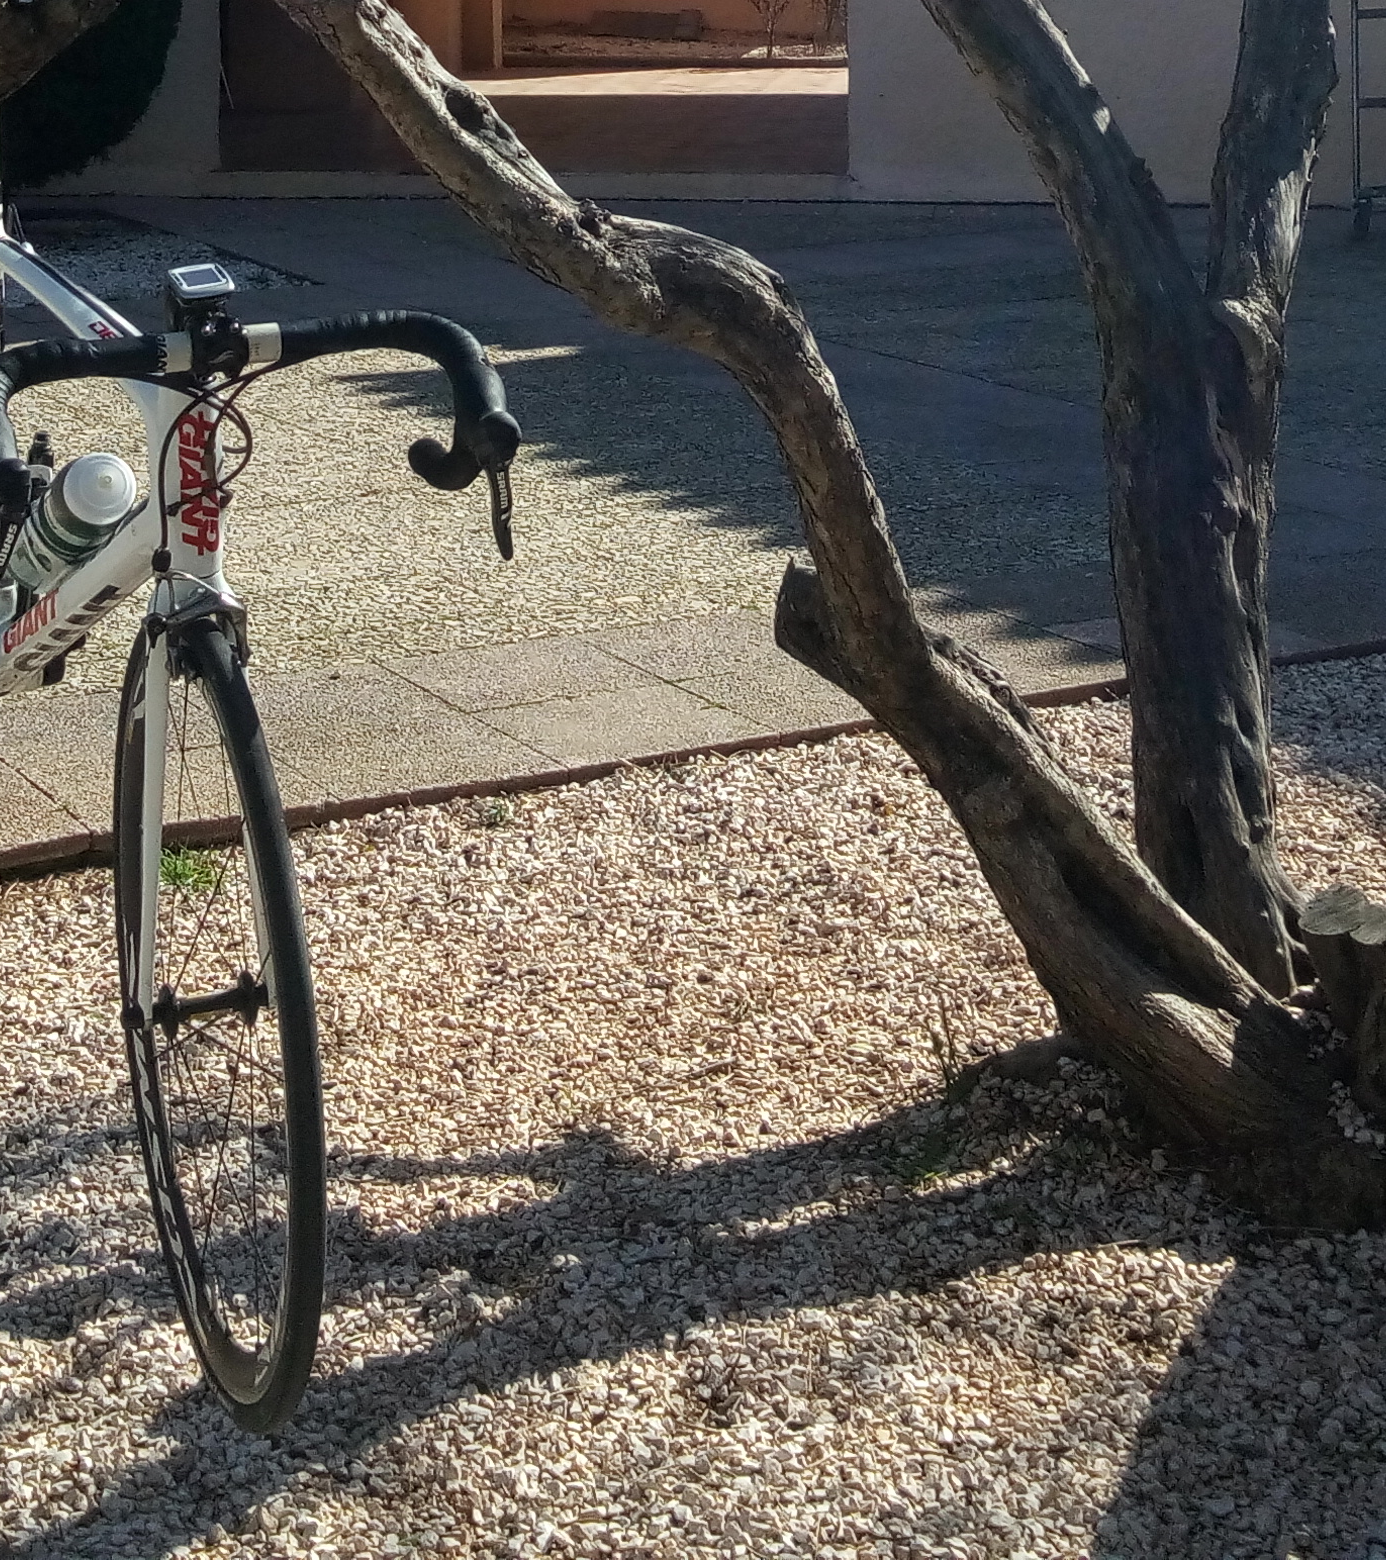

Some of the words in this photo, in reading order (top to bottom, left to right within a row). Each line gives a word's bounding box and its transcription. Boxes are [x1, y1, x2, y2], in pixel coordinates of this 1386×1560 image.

[178, 413, 205, 556] GIANT
[496, 471, 509, 509] SRAM
[3, 588, 60, 654] GIANT
